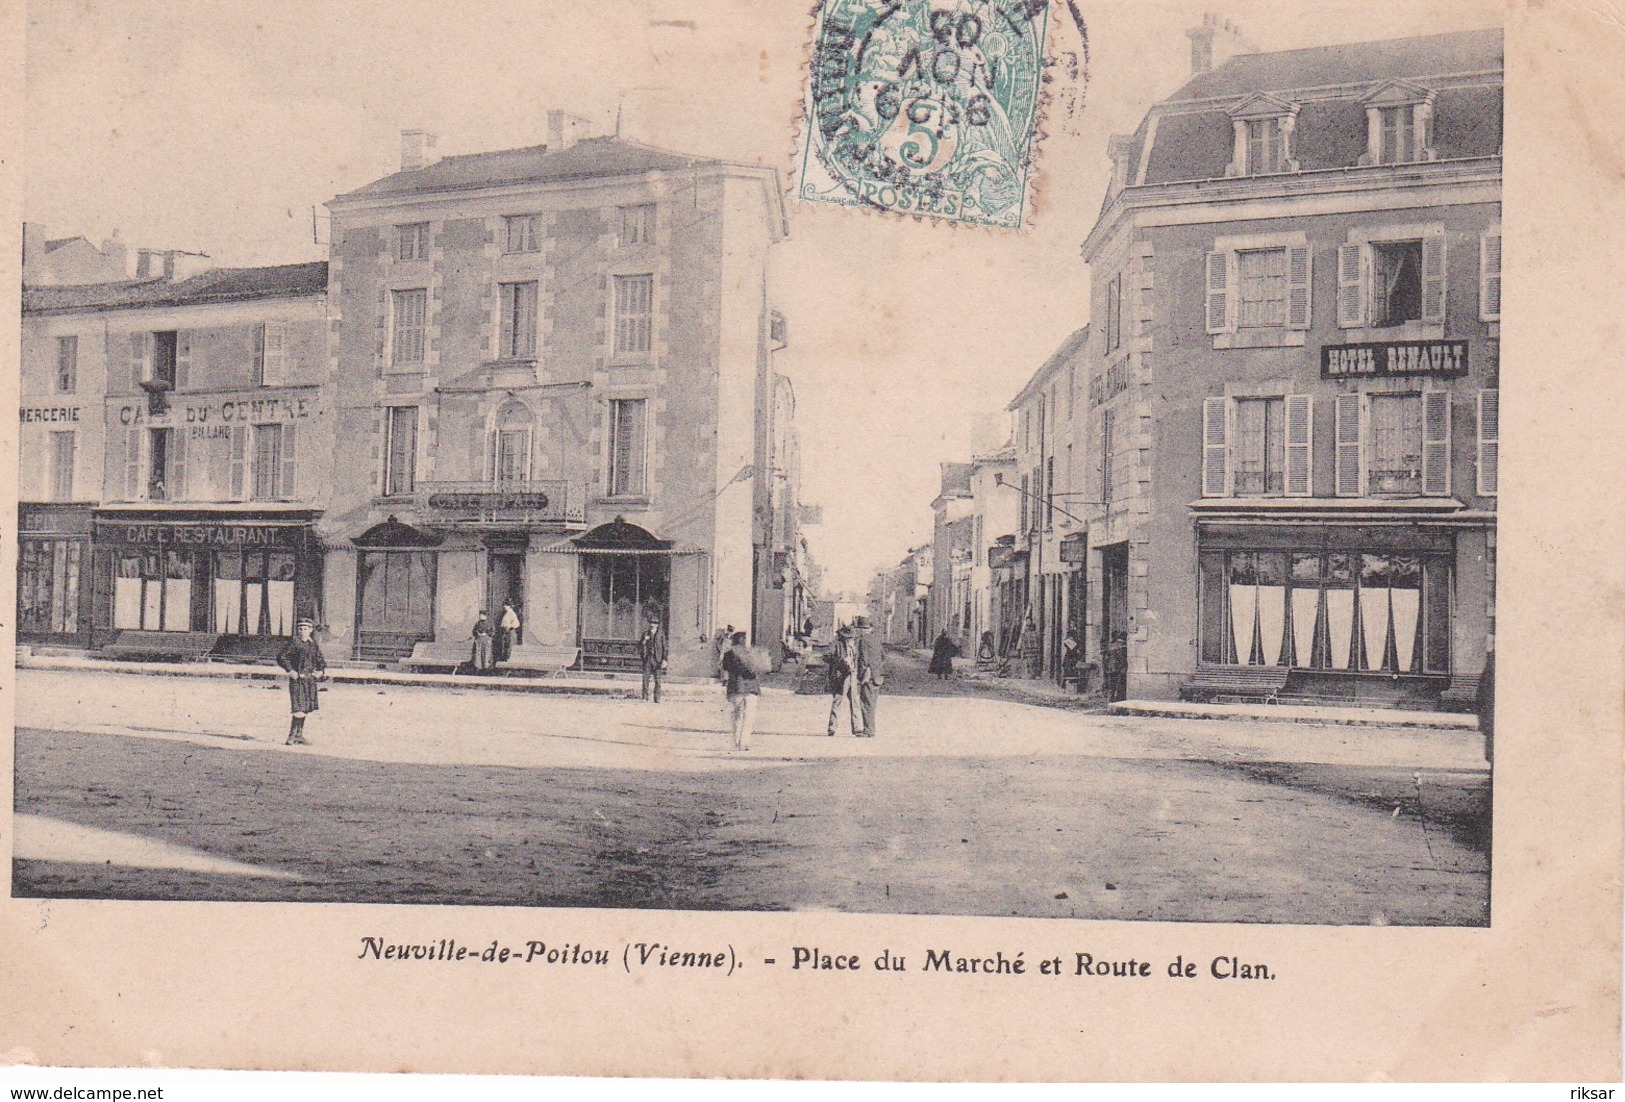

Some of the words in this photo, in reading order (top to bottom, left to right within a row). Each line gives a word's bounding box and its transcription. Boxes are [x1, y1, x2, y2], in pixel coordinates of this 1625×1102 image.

[898, 48, 998, 89] NOV
[863, 181, 962, 216] POSTES
[1328, 348, 1376, 374] HOTEL
[1386, 345, 1463, 372] RENAULT
[186, 404, 211, 423] DU
[221, 399, 309, 422] CENTRE
[174, 526, 279, 544] RESTAURANT
